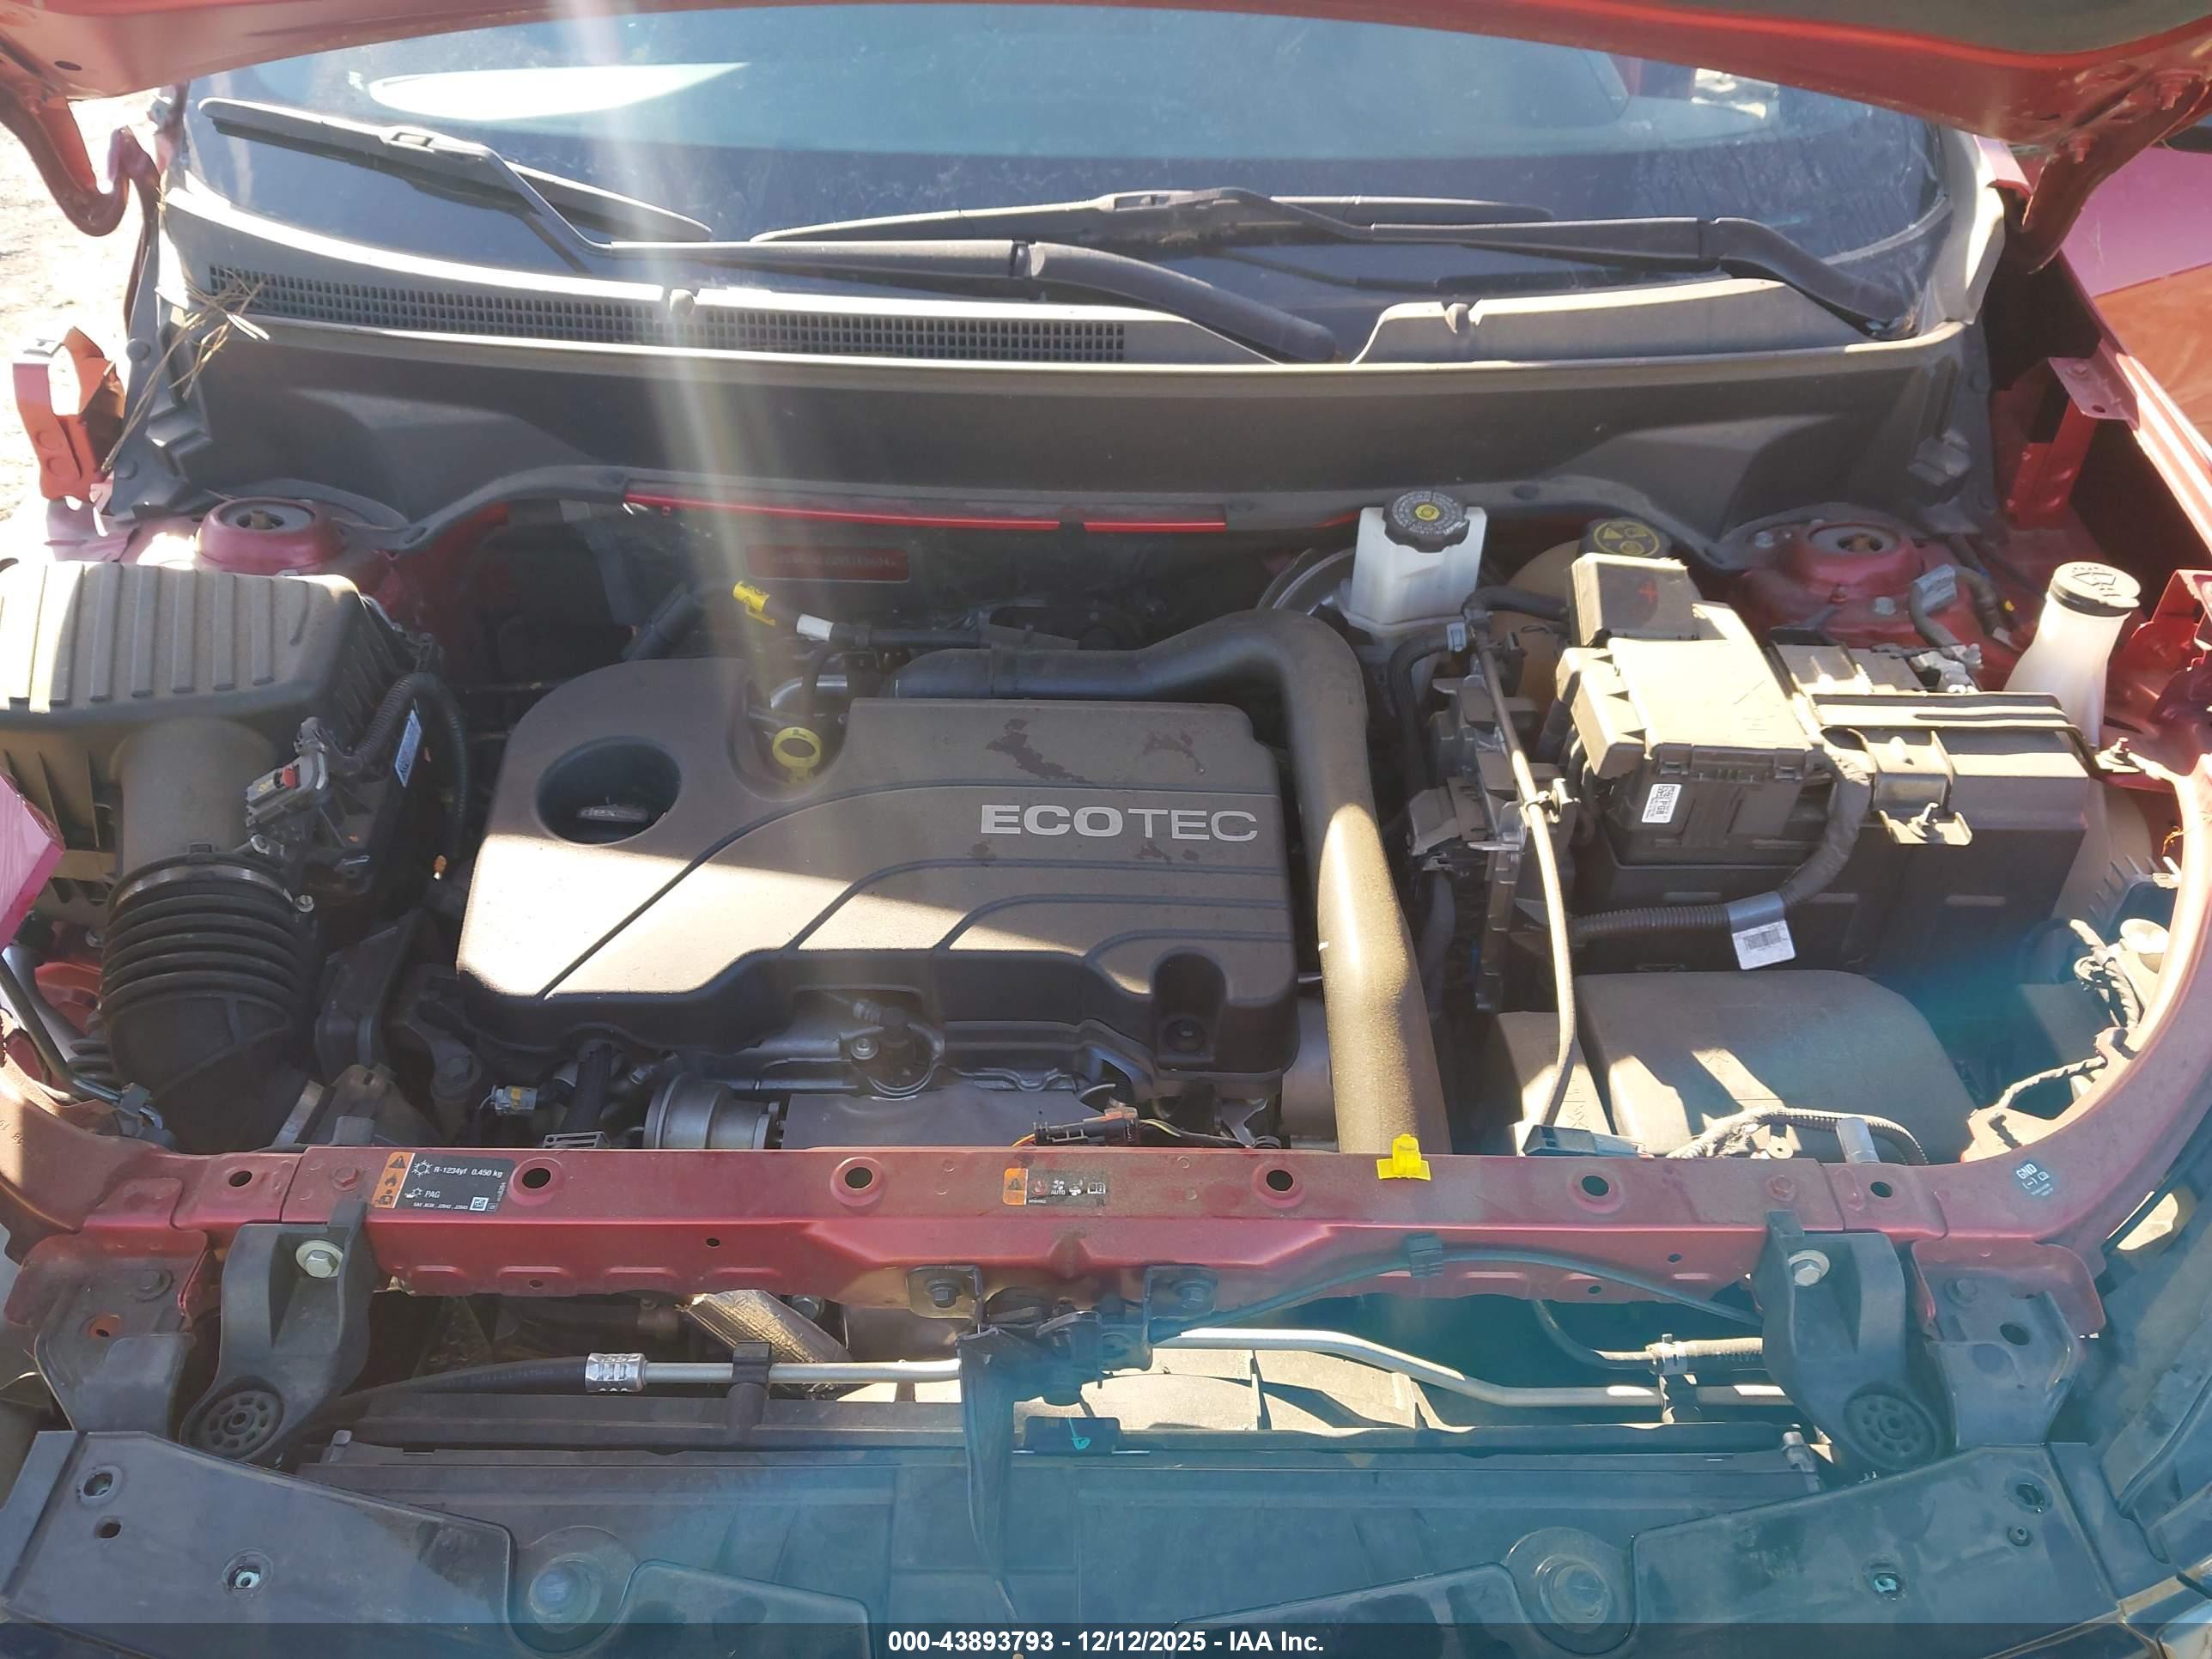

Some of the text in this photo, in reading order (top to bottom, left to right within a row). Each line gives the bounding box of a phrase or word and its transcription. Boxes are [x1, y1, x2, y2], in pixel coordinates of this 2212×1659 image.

[981, 805, 1258, 842] ECOTEC
[434, 1166, 468, 1176] R-1234yf
[492, 1169, 503, 1178] kg
[2016, 1163, 2037, 1180] GND
